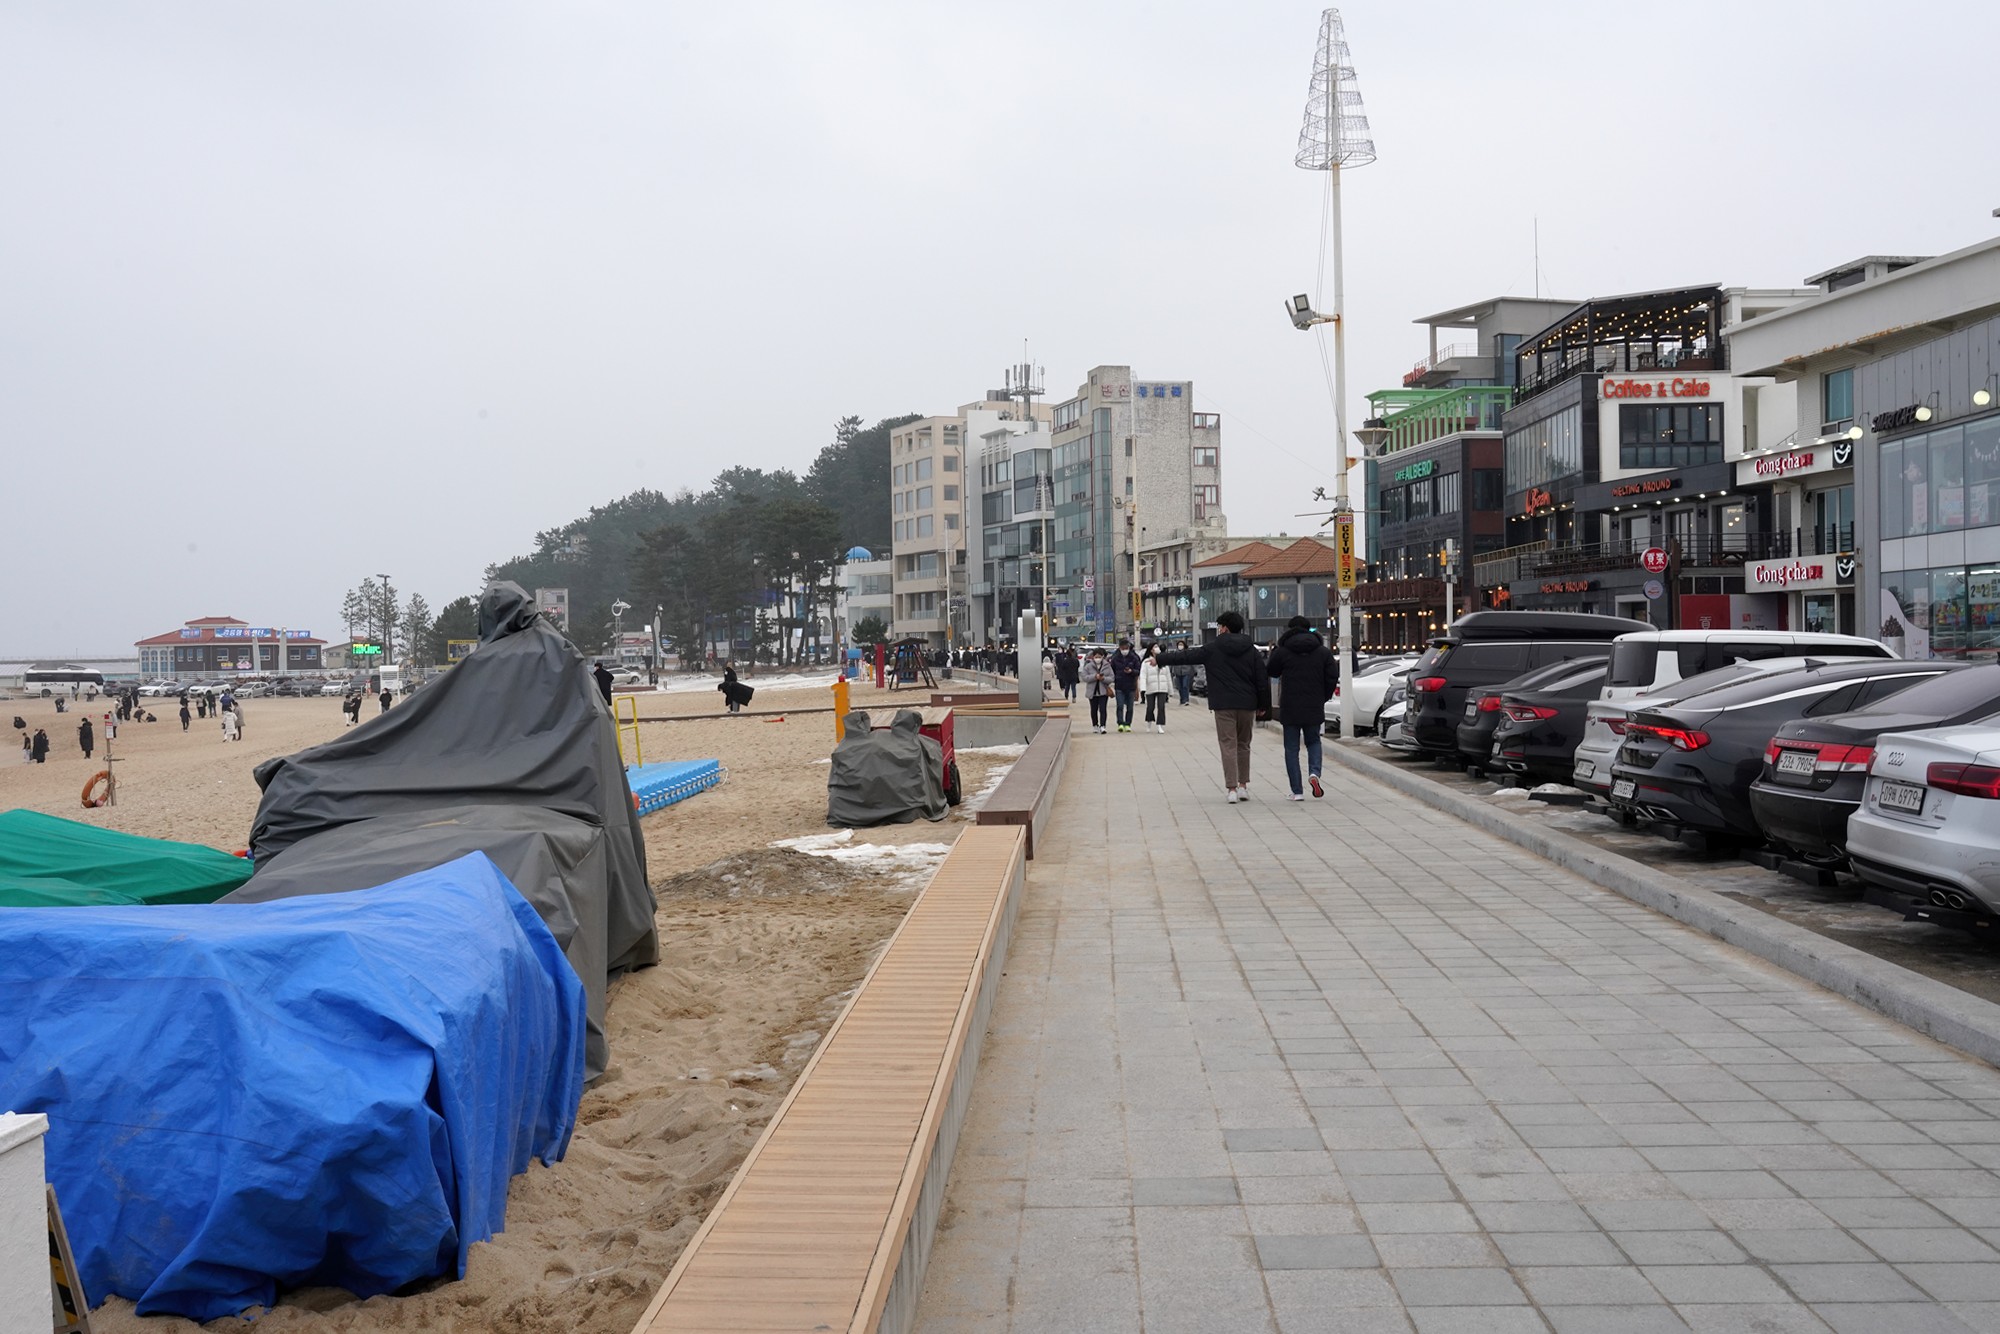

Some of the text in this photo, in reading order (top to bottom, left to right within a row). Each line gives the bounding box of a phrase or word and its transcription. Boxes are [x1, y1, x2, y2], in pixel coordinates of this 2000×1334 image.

[1603, 378, 1710, 399] Coffee & Cake
[1405, 460, 1432, 480] ALBERO
[1754, 456, 1784, 476] Gong
[1783, 452, 1801, 470] cha
[1611, 478, 1671, 497] MELTING AROUND
[1754, 564, 1787, 587] Gong
[1786, 561, 1808, 581] cha
[1541, 580, 1589, 594] MELTING AROUND
[1796, 757, 1813, 772] 7905
[1898, 788, 1918, 807] 6979
